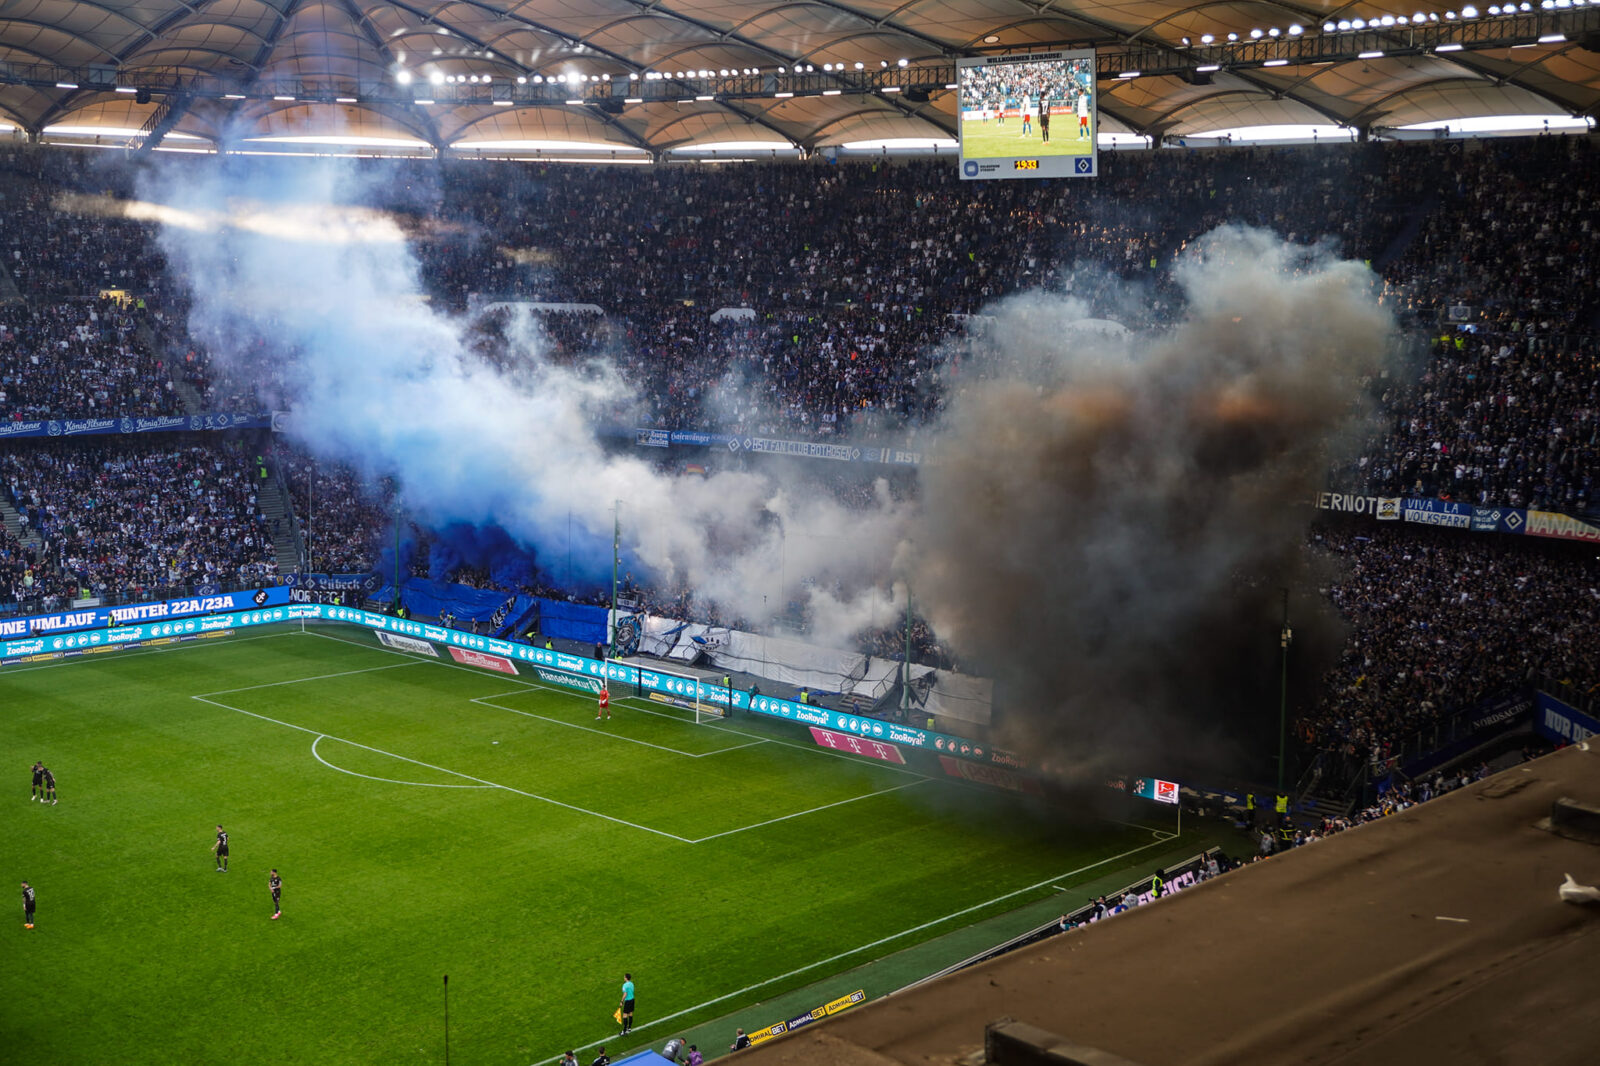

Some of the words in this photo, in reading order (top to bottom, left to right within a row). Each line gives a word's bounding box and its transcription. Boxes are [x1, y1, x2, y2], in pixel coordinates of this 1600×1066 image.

[1407, 498, 1433, 511] VIVA
[1444, 502, 1459, 514] LA
[1407, 510, 1467, 527] VOLKSPARK
[0, 620, 26, 636] NE
[29, 612, 96, 631] UMLAUF
[111, 604, 168, 621] HINTER
[171, 596, 234, 615] 22A/23A
[201, 619, 232, 631] ZooRoyal
[107, 631, 140, 642] ZooRoyal
[7, 644, 42, 655] ZooRoyal
[538, 669, 590, 690] HanseMerkur
[796, 710, 827, 725] ZooRoyal
[1544, 708, 1571, 738] NUR
[889, 730, 922, 746] ZooRoyal
